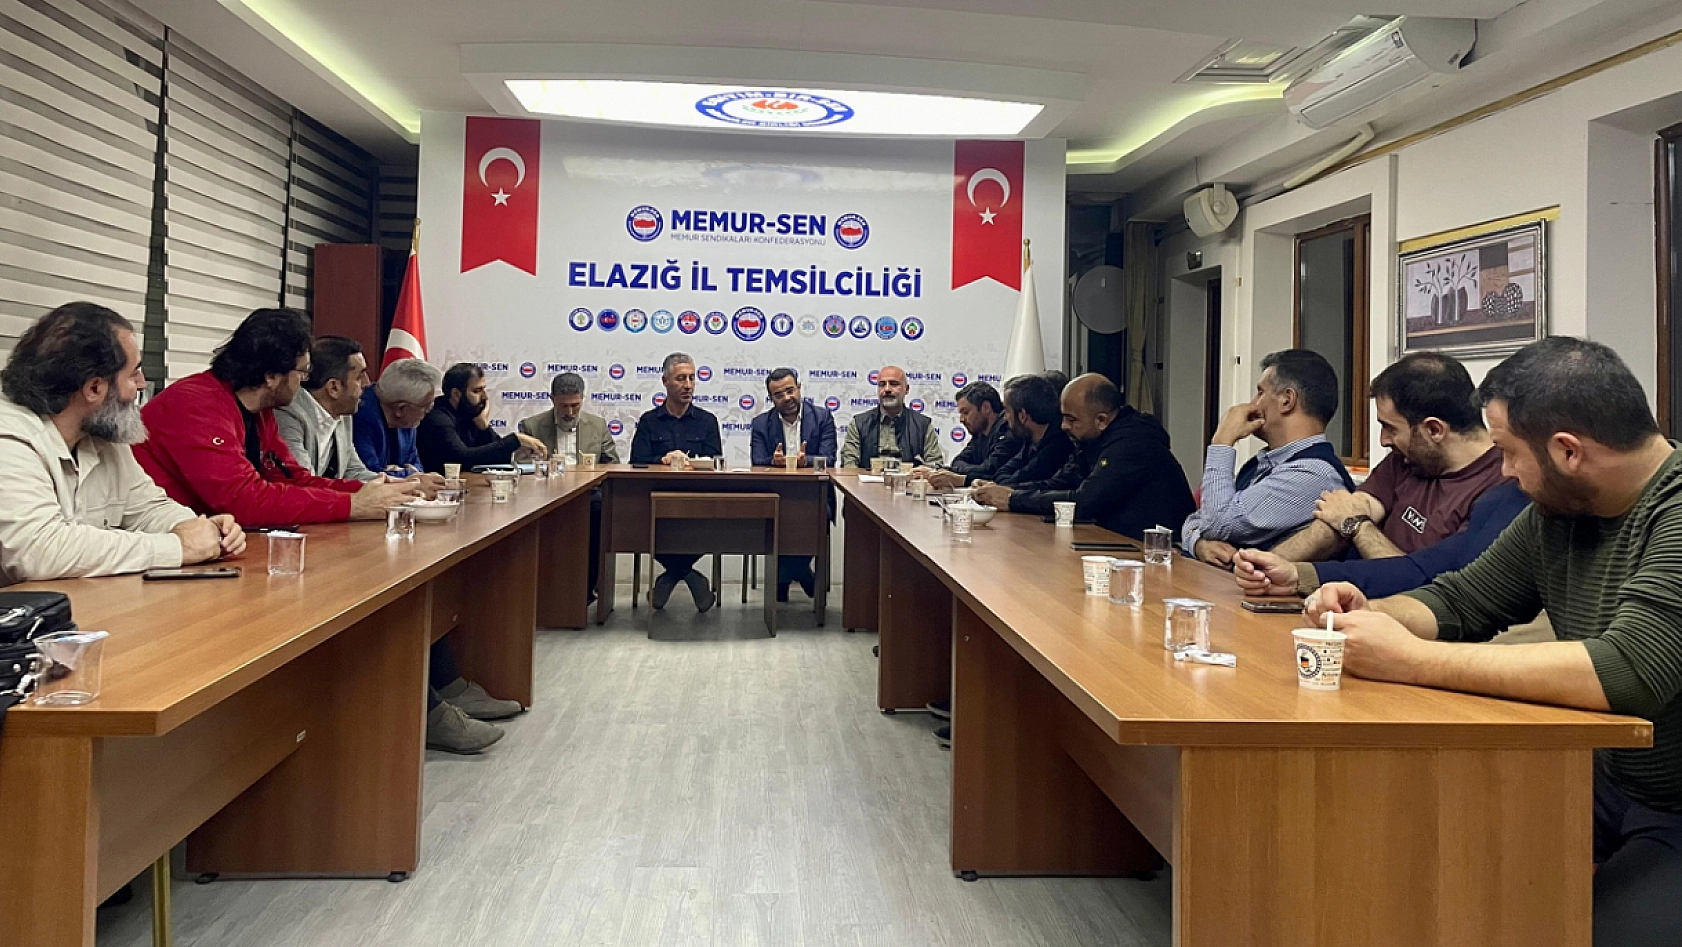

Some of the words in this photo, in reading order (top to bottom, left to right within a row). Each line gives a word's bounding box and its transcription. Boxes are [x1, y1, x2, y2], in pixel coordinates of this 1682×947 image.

[671, 209, 827, 236] MEMUR-SEN
[671, 233, 700, 241] MEMUR
[754, 236, 827, 246] KONFEDERASYONU
[568, 259, 682, 291] ELAZIĞ
[691, 260, 718, 291] İL
[726, 264, 921, 298] TEMSİLCİLİĞİ
[547, 364, 598, 372] MEMUR-SEN
[808, 370, 857, 379] MEMUR-SEN
[905, 372, 942, 381] MUR-SEN
[591, 393, 642, 401] MEMUR-SEN
[691, 395, 729, 403] MUR-SEN
